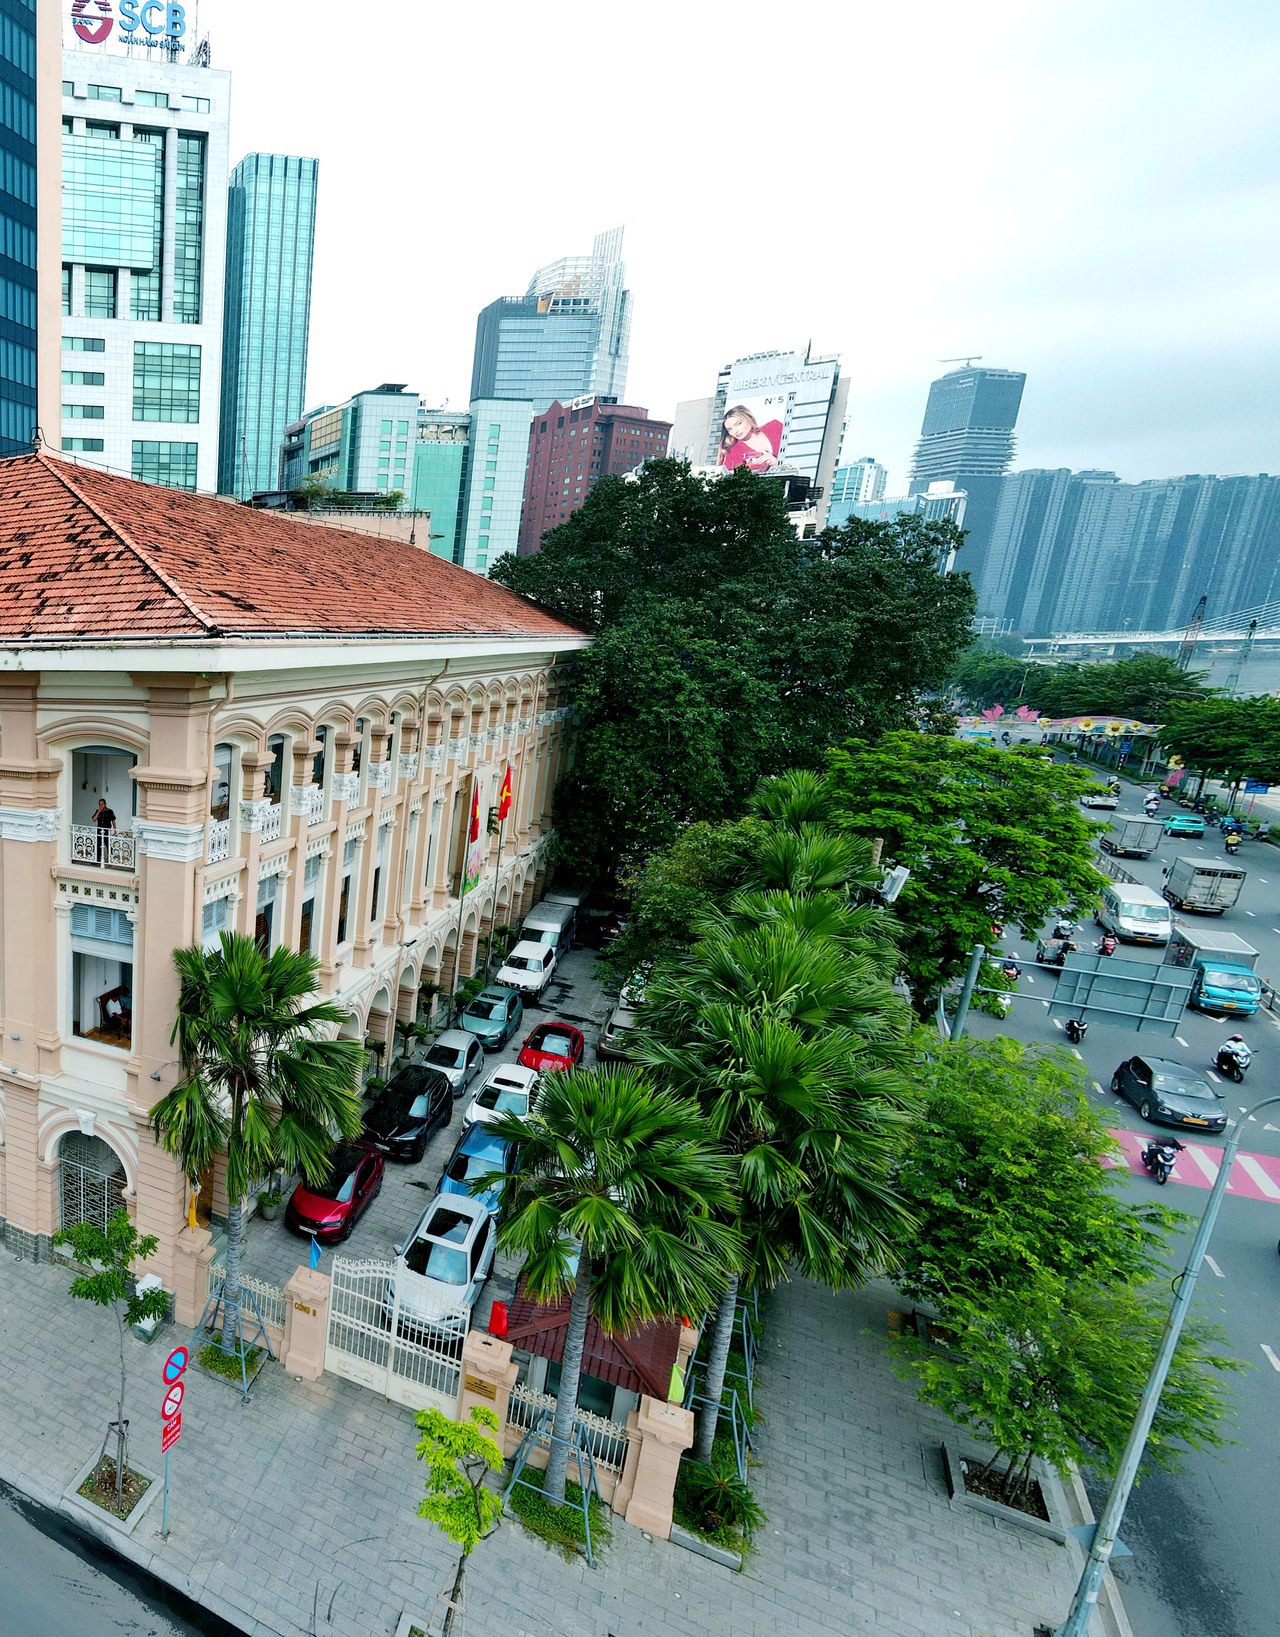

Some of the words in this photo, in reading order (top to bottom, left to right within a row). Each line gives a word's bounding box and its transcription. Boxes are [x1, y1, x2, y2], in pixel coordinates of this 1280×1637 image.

[118, 0, 186, 37] SCB
[734, 376, 778, 391] LIBERTY
[777, 368, 830, 385] CENTRAL
